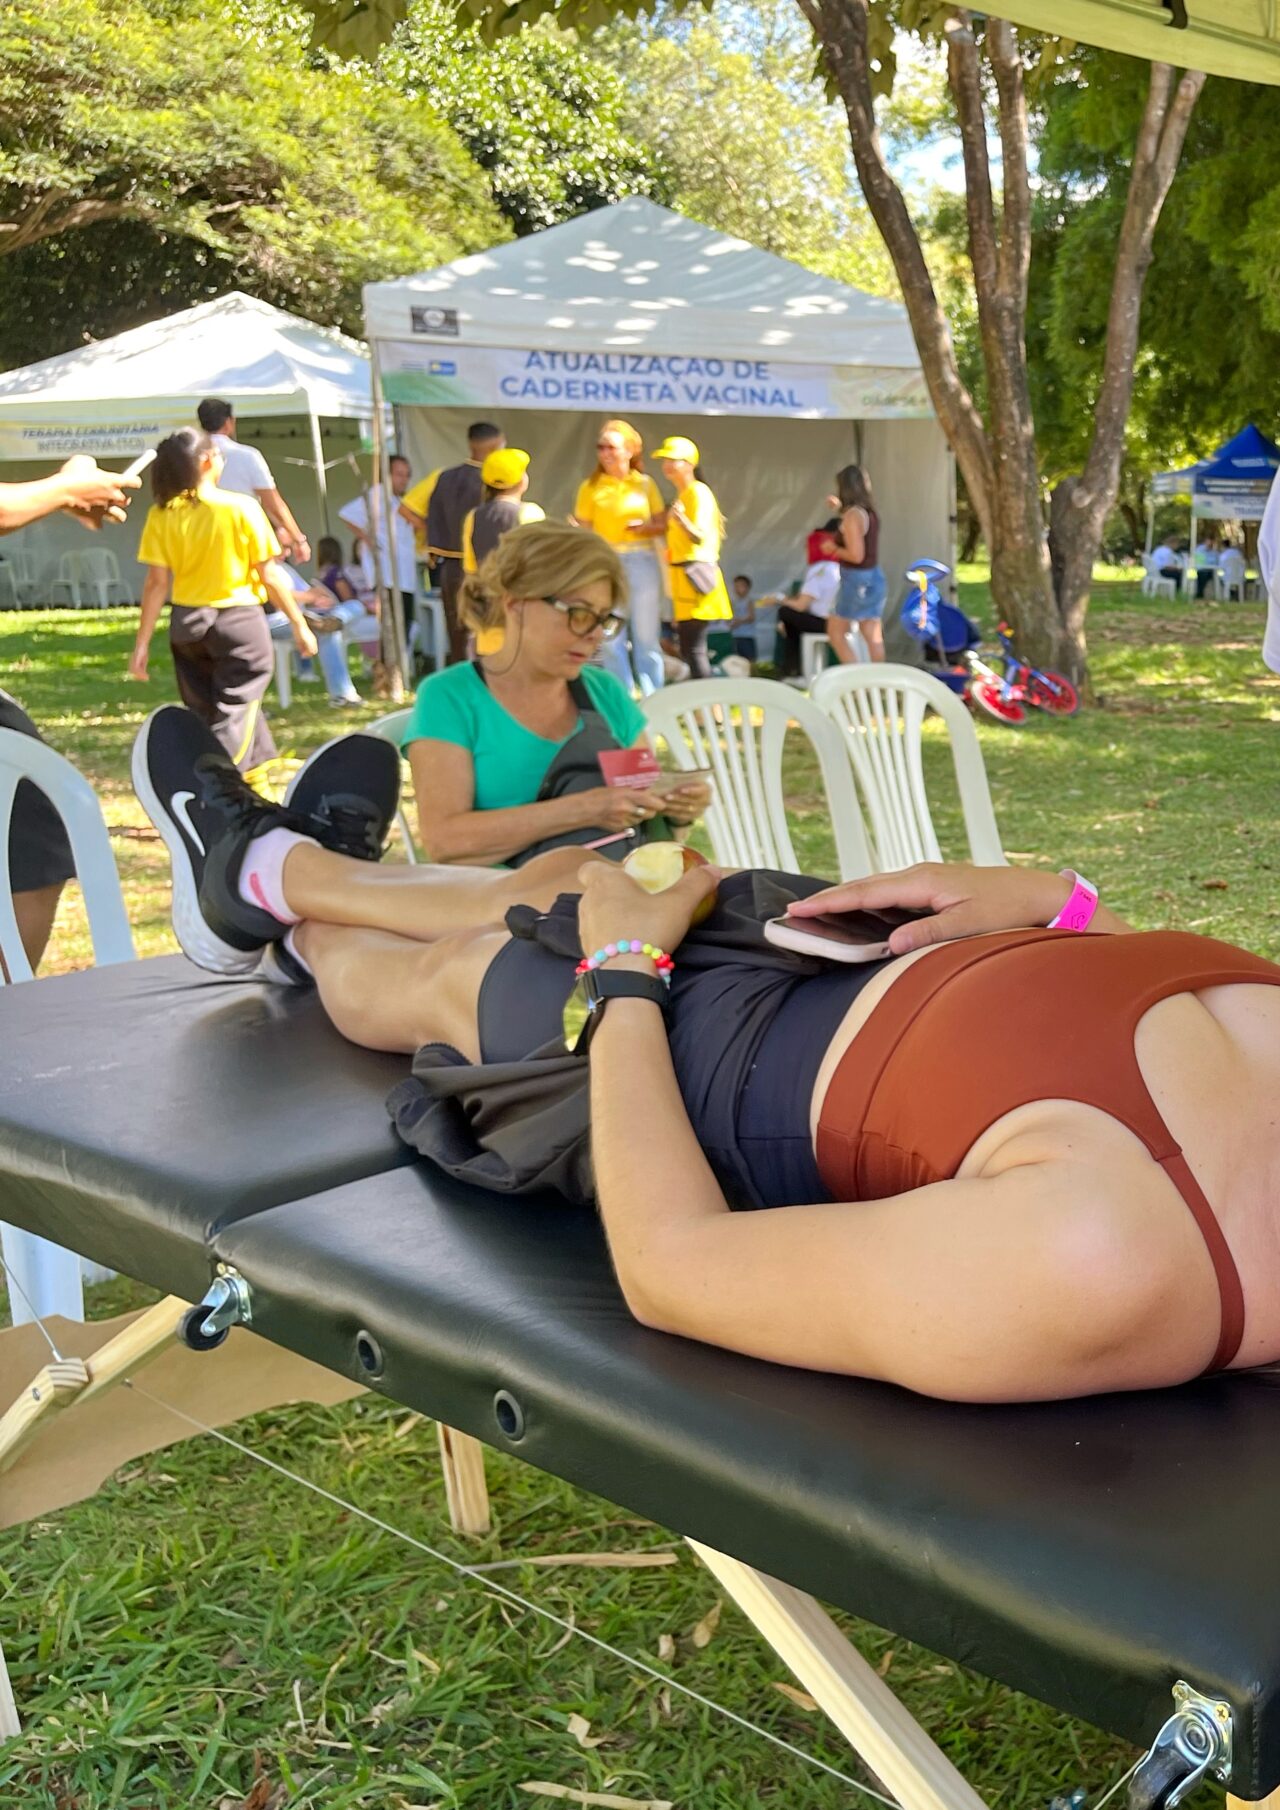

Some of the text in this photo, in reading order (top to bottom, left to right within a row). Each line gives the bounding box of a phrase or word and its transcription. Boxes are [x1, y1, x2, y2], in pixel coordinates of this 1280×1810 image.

[734, 359, 770, 380] DE
[500, 376, 803, 408] CADERNETA VACINAL
